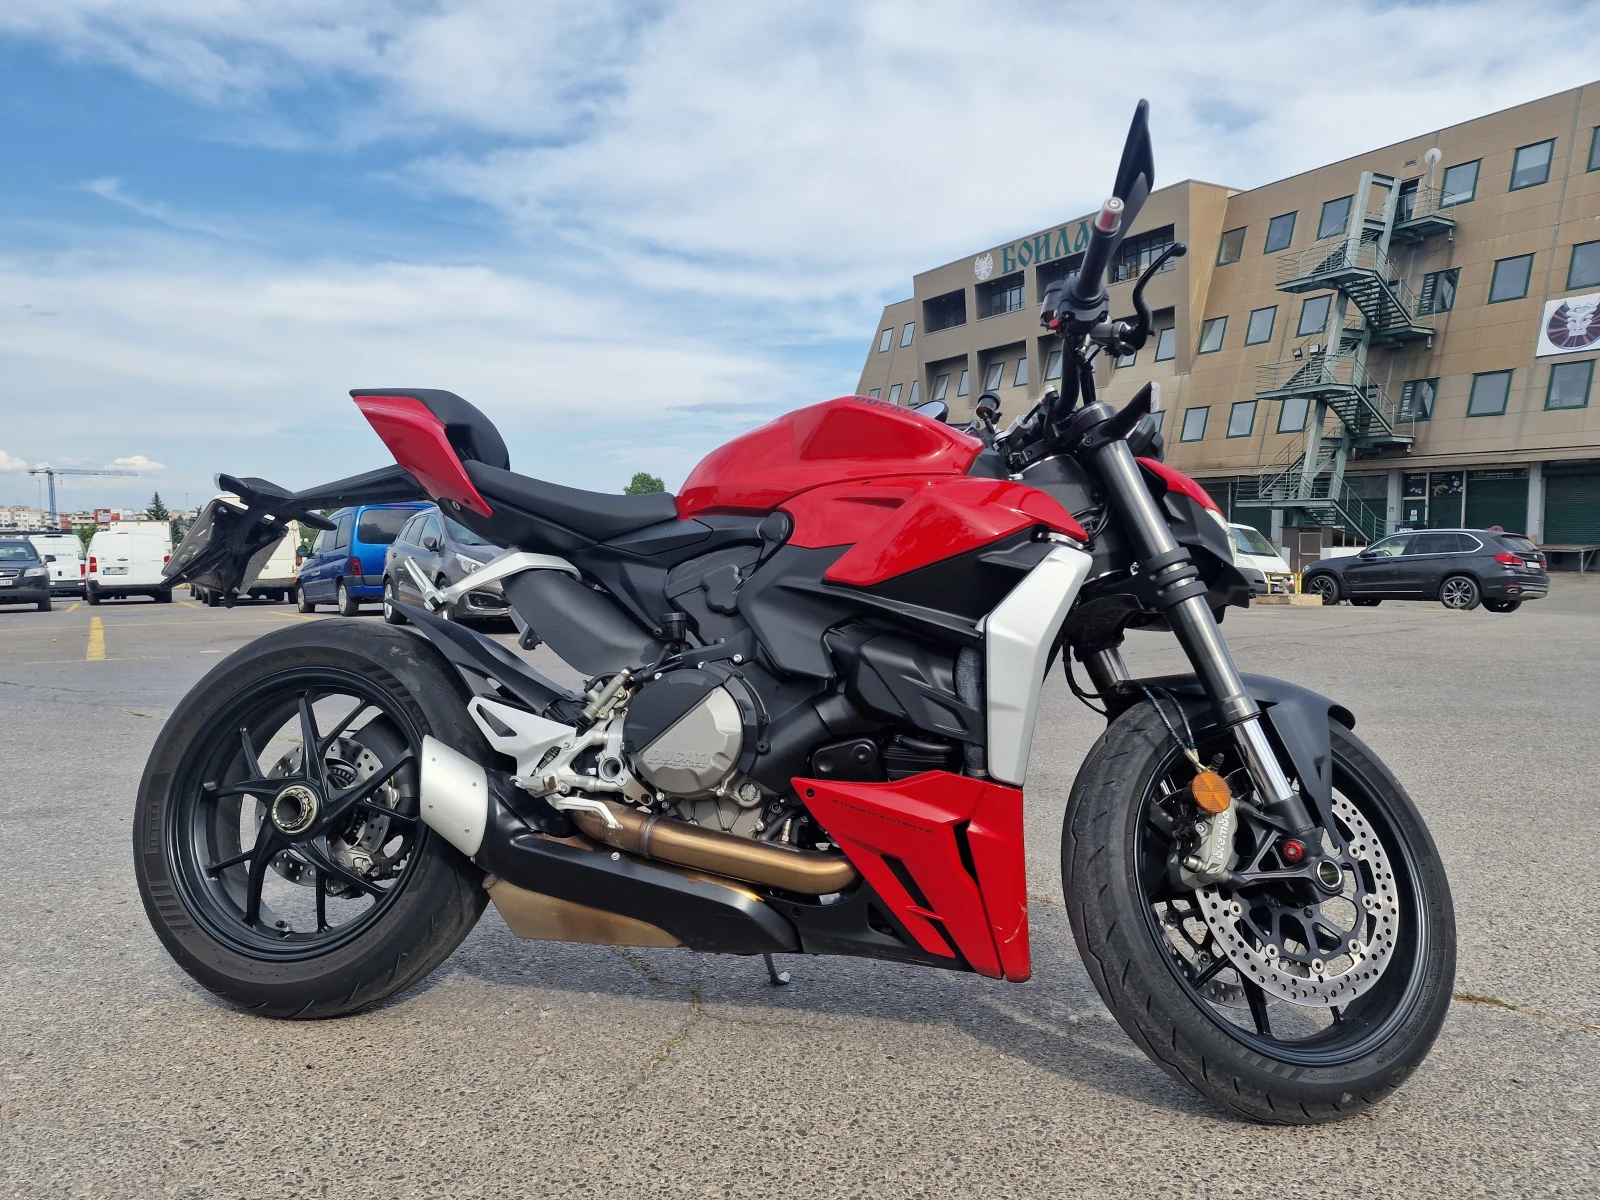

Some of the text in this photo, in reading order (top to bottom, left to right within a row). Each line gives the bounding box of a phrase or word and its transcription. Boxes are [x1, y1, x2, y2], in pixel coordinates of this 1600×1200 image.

[851, 395, 920, 418] DUCATI
[647, 749, 714, 767] DUCATI
[1212, 811, 1231, 861] brembo
